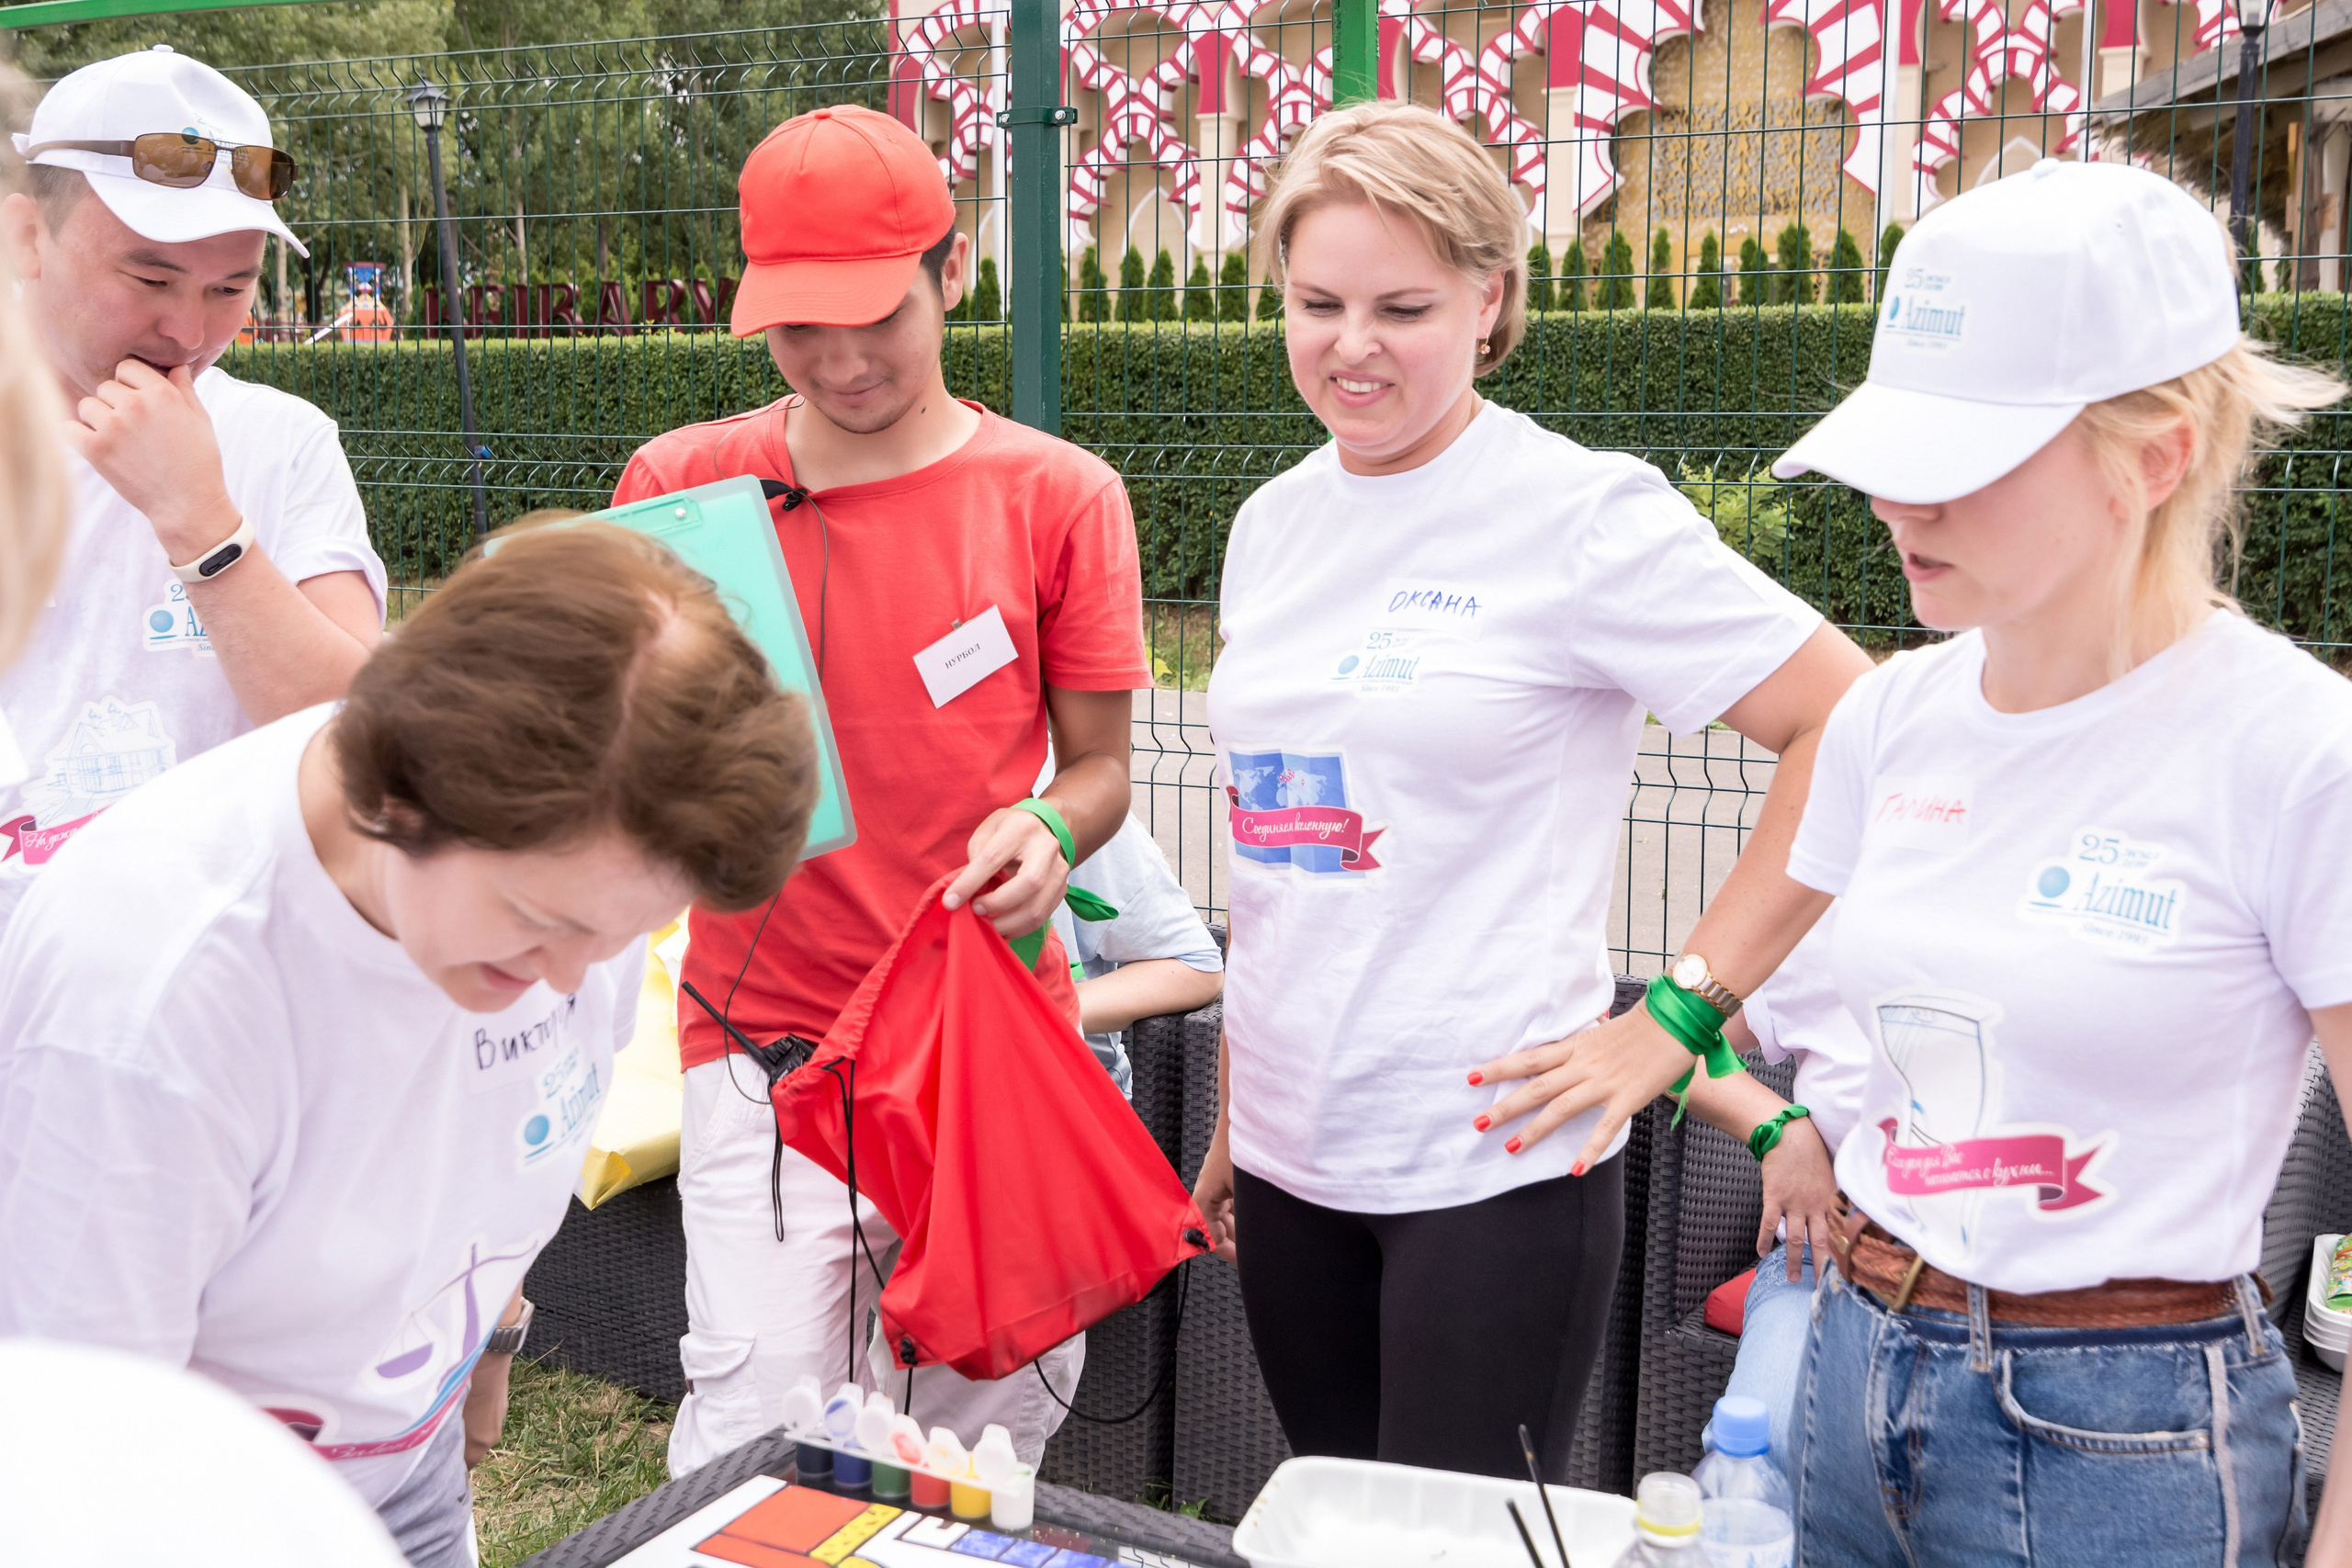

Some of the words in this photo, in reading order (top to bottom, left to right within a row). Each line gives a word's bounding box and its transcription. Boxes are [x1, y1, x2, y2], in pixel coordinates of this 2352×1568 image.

[1901, 295, 1965, 336] Azimut
[1388, 591, 1482, 618] ОКСАНА
[1366, 631, 1394, 650] 25
[944, 643, 981, 670] НУРБОЛ
[1356, 653, 1421, 681] Azimut
[1874, 793, 1968, 824] ГАЛИНА
[2078, 834, 2120, 865] 25
[2073, 872, 2177, 931] Azimut
